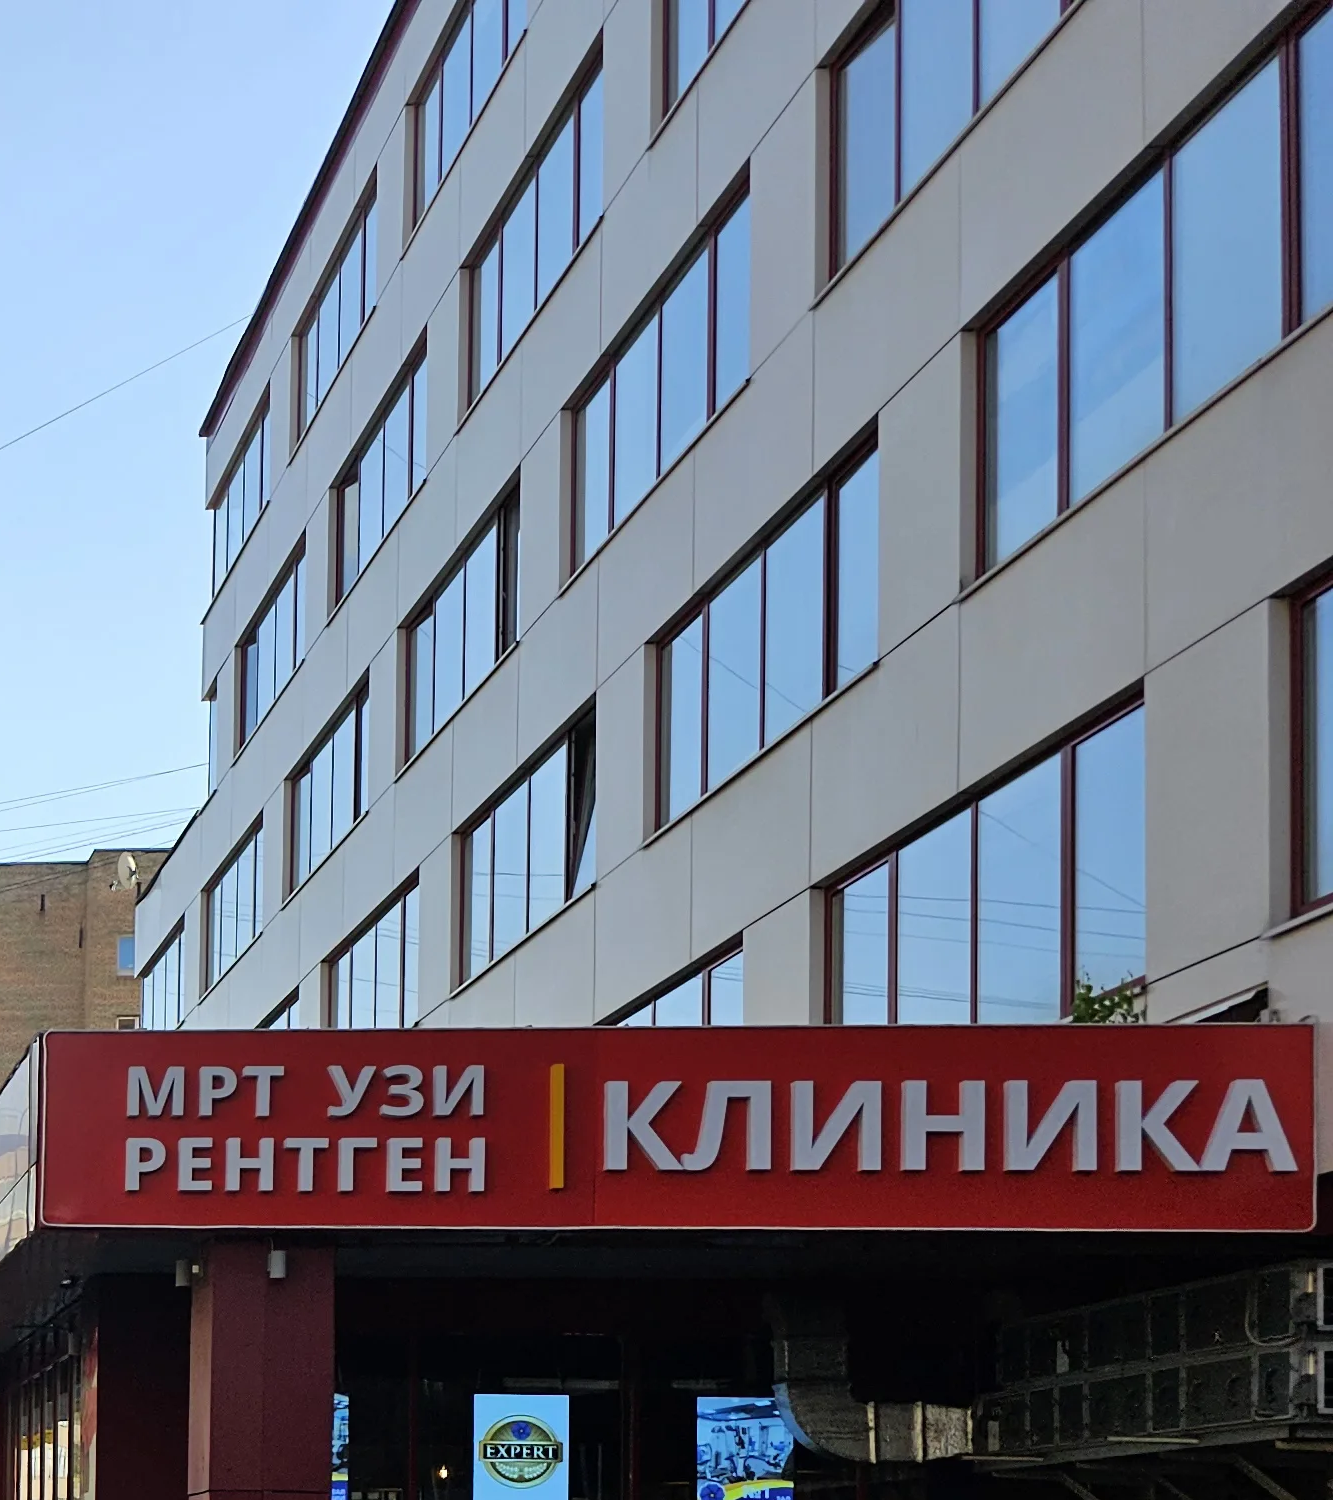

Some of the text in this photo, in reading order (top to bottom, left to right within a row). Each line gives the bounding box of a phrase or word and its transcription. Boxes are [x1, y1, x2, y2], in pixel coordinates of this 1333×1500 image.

[126, 1064, 485, 1119] МРТ УЗИ
[603, 1078, 1300, 1173] КЛИНИКА
[124, 1136, 486, 1193] РЕНТГЕН
[485, 1444, 558, 1459] EXPERT
